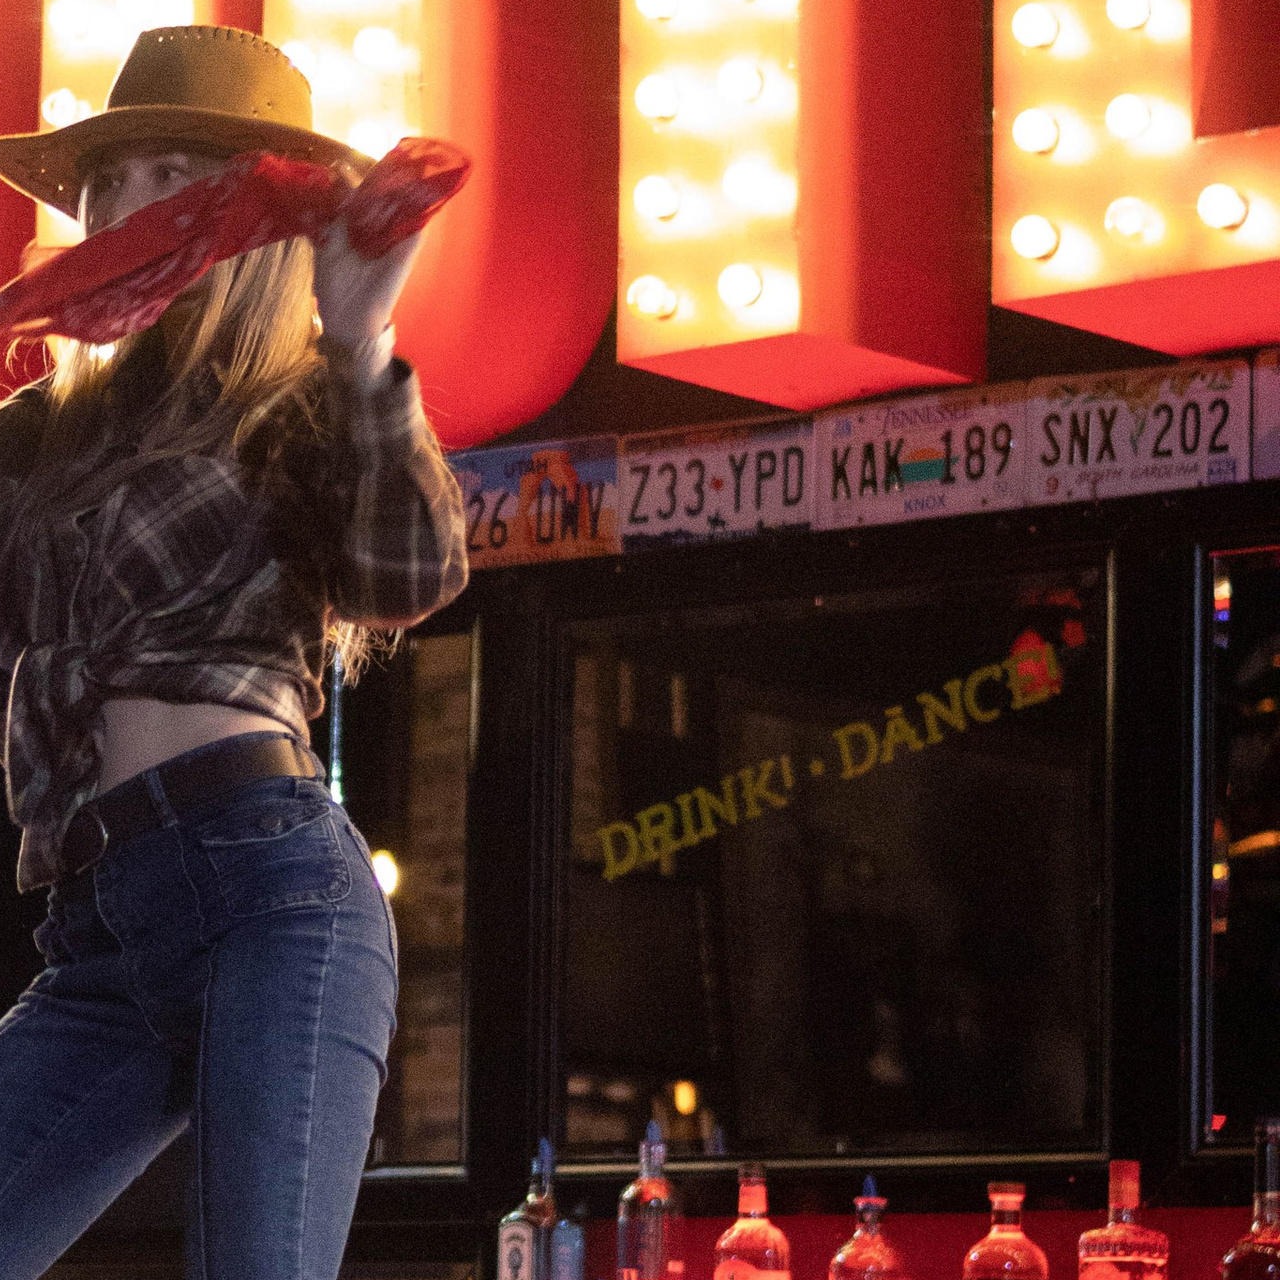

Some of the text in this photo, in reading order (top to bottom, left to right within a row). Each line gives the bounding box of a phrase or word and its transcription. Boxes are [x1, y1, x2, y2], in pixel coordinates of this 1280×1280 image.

[831, 422, 1013, 501] KAK 189
[1040, 398, 1229, 467] SNX 202
[504, 459, 548, 478] UTAH
[628, 445, 804, 523] Z33 YPD
[466, 491, 509, 551] 26
[904, 494, 946, 513] KNOX
[596, 644, 1063, 881] DRINK! DANCE!
